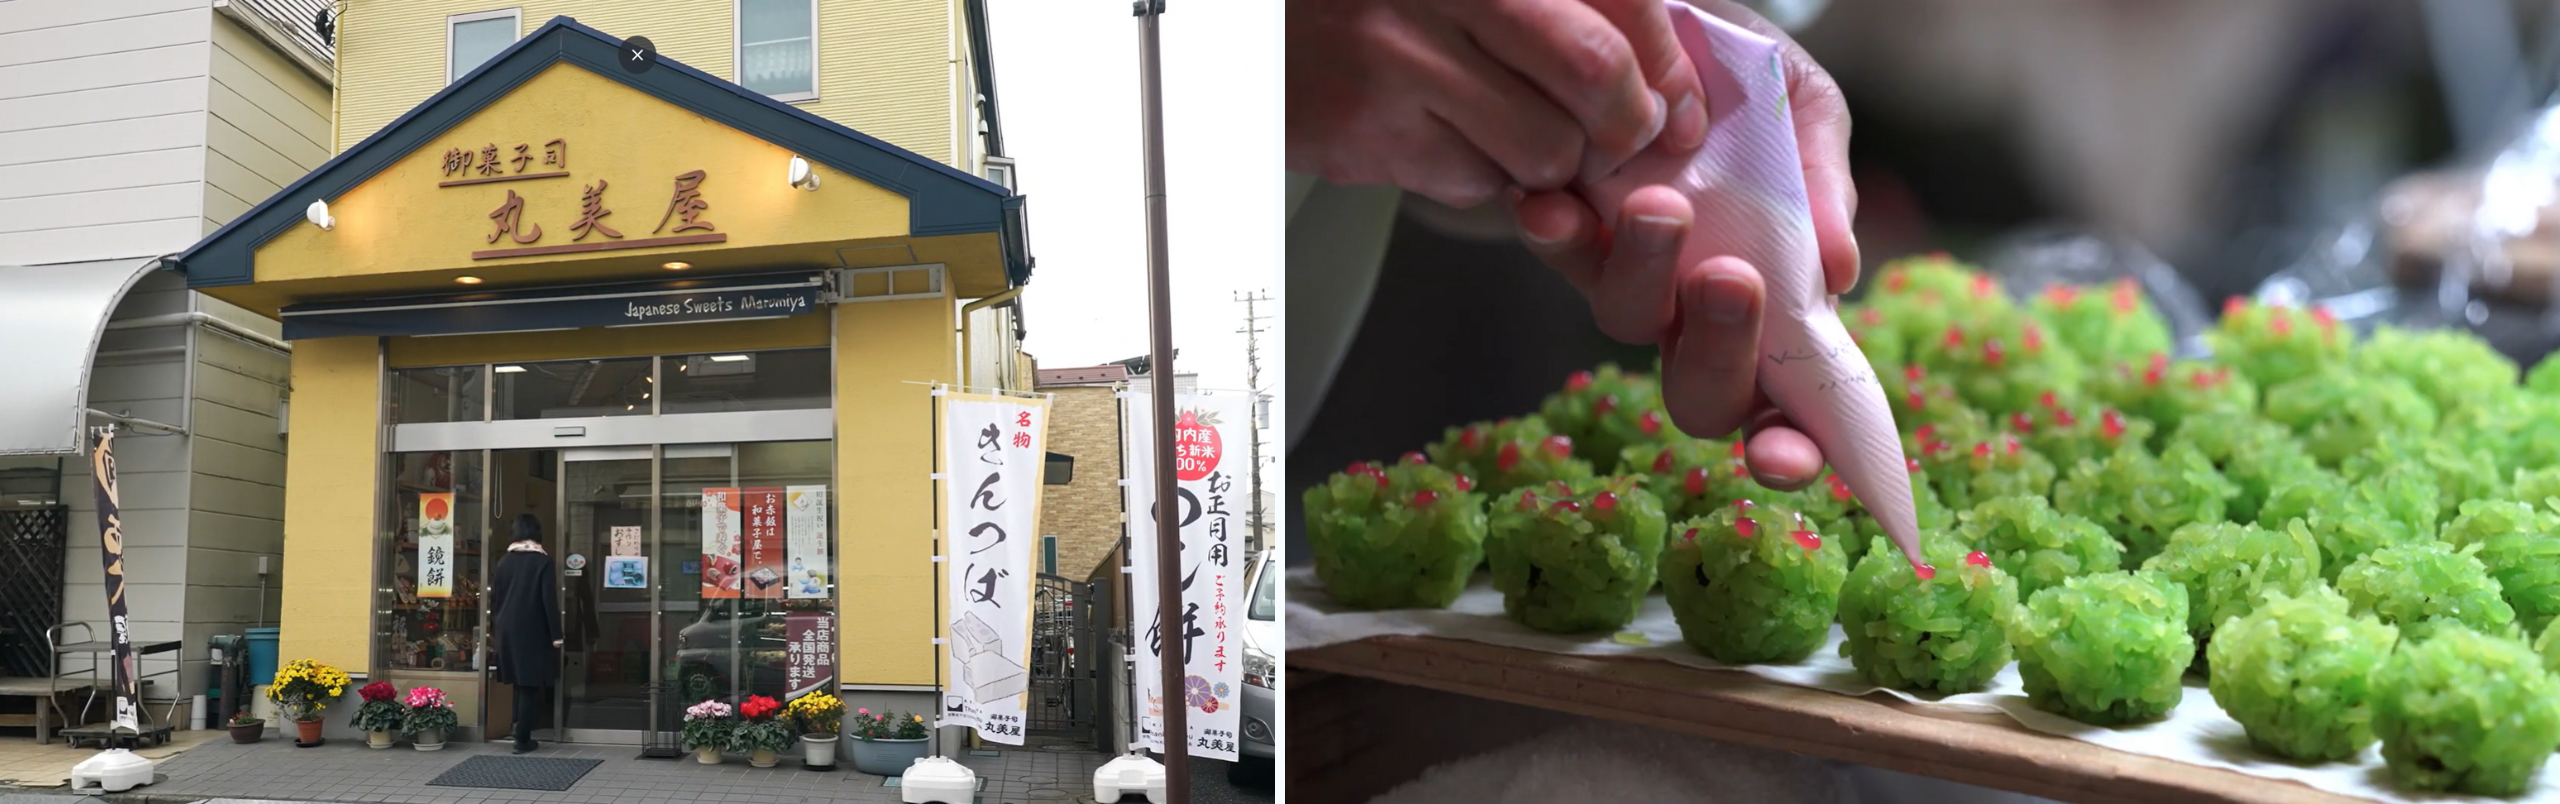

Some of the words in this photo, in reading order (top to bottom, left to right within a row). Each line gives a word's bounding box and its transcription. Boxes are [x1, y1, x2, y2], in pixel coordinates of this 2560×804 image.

[441, 137, 567, 177] 御菓子司
[486, 169, 715, 245] 丸美屋
[624, 301, 681, 320] Japanese
[684, 296, 733, 314] Sweets
[741, 293, 806, 312] Marumiya
[1012, 410, 1032, 449] 名物
[1175, 443, 1216, 459] ち新米
[1176, 457, 1207, 472] 00%
[765, 493, 777, 537] お赤飯は
[963, 422, 1010, 609] きんつば
[1207, 470, 1232, 568] お正月用
[614, 527, 624, 556] おすし
[426, 546, 446, 587] 鏡餅
[816, 616, 830, 666] 当店商品
[1213, 574, 1227, 673] ご予約承ります
[788, 641, 802, 690] 承ります
[802, 629, 816, 678] 全国発送
[984, 721, 1021, 737] 丸美屋
[1197, 736, 1236, 753] 丸美屋
